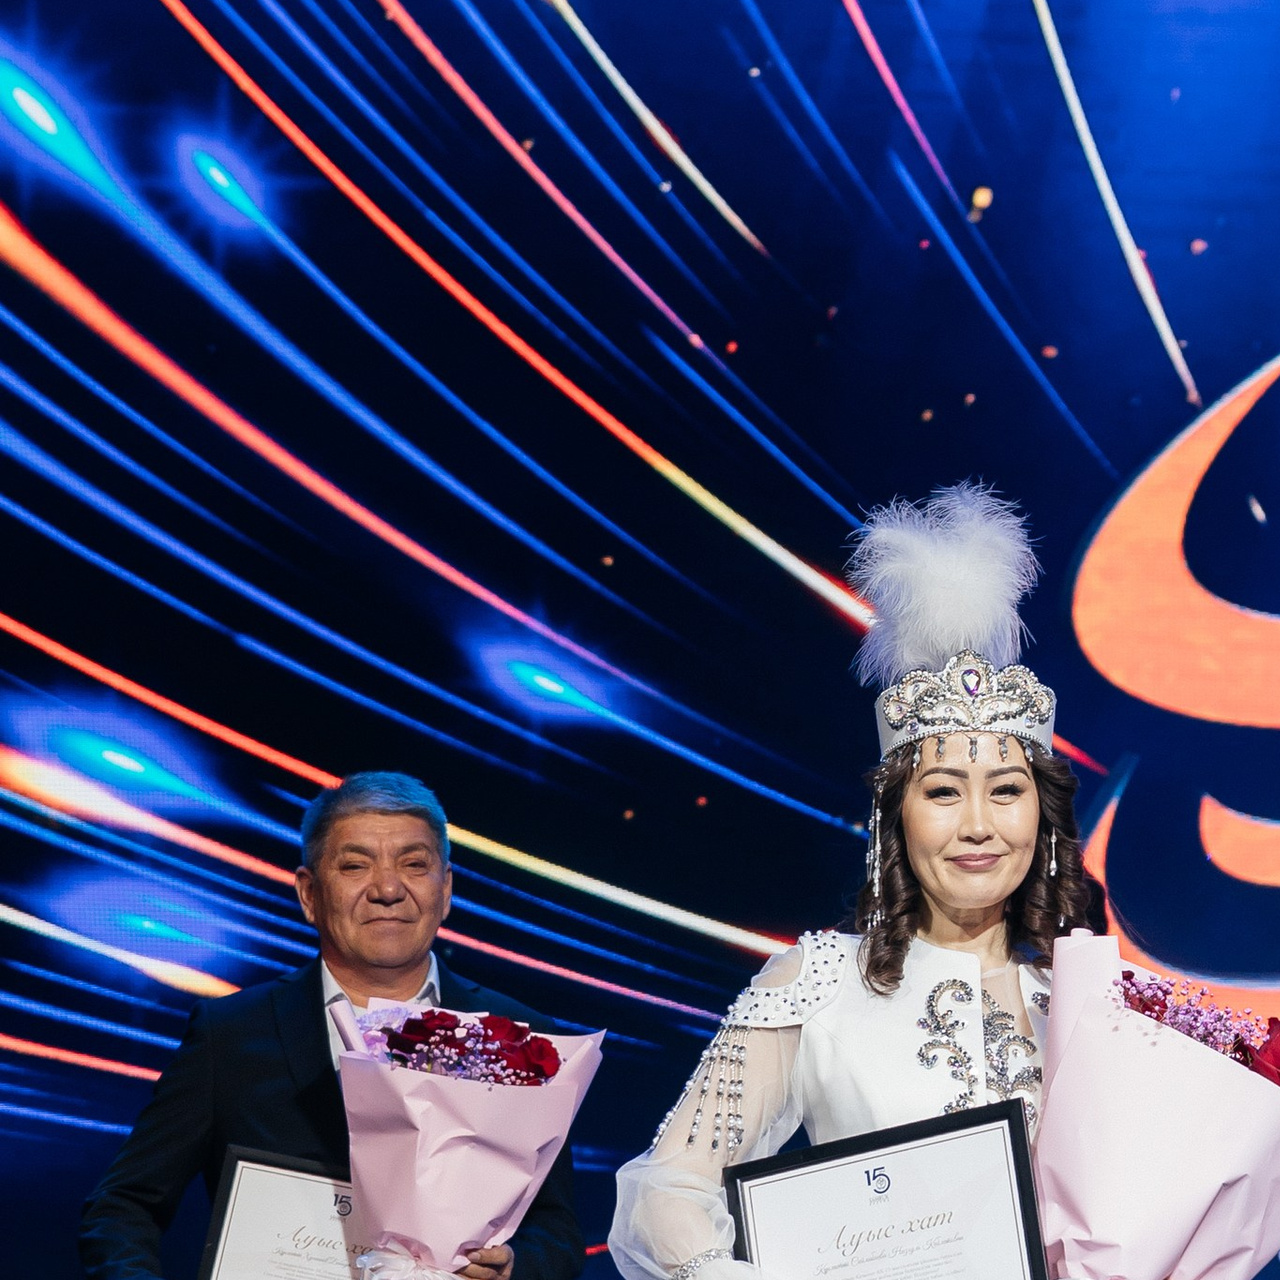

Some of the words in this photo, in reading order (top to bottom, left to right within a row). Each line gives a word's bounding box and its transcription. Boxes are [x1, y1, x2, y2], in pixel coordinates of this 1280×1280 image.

[864, 1166, 891, 1194] 15
[333, 1193, 353, 1216] 15
[901, 1210, 953, 1234] хат
